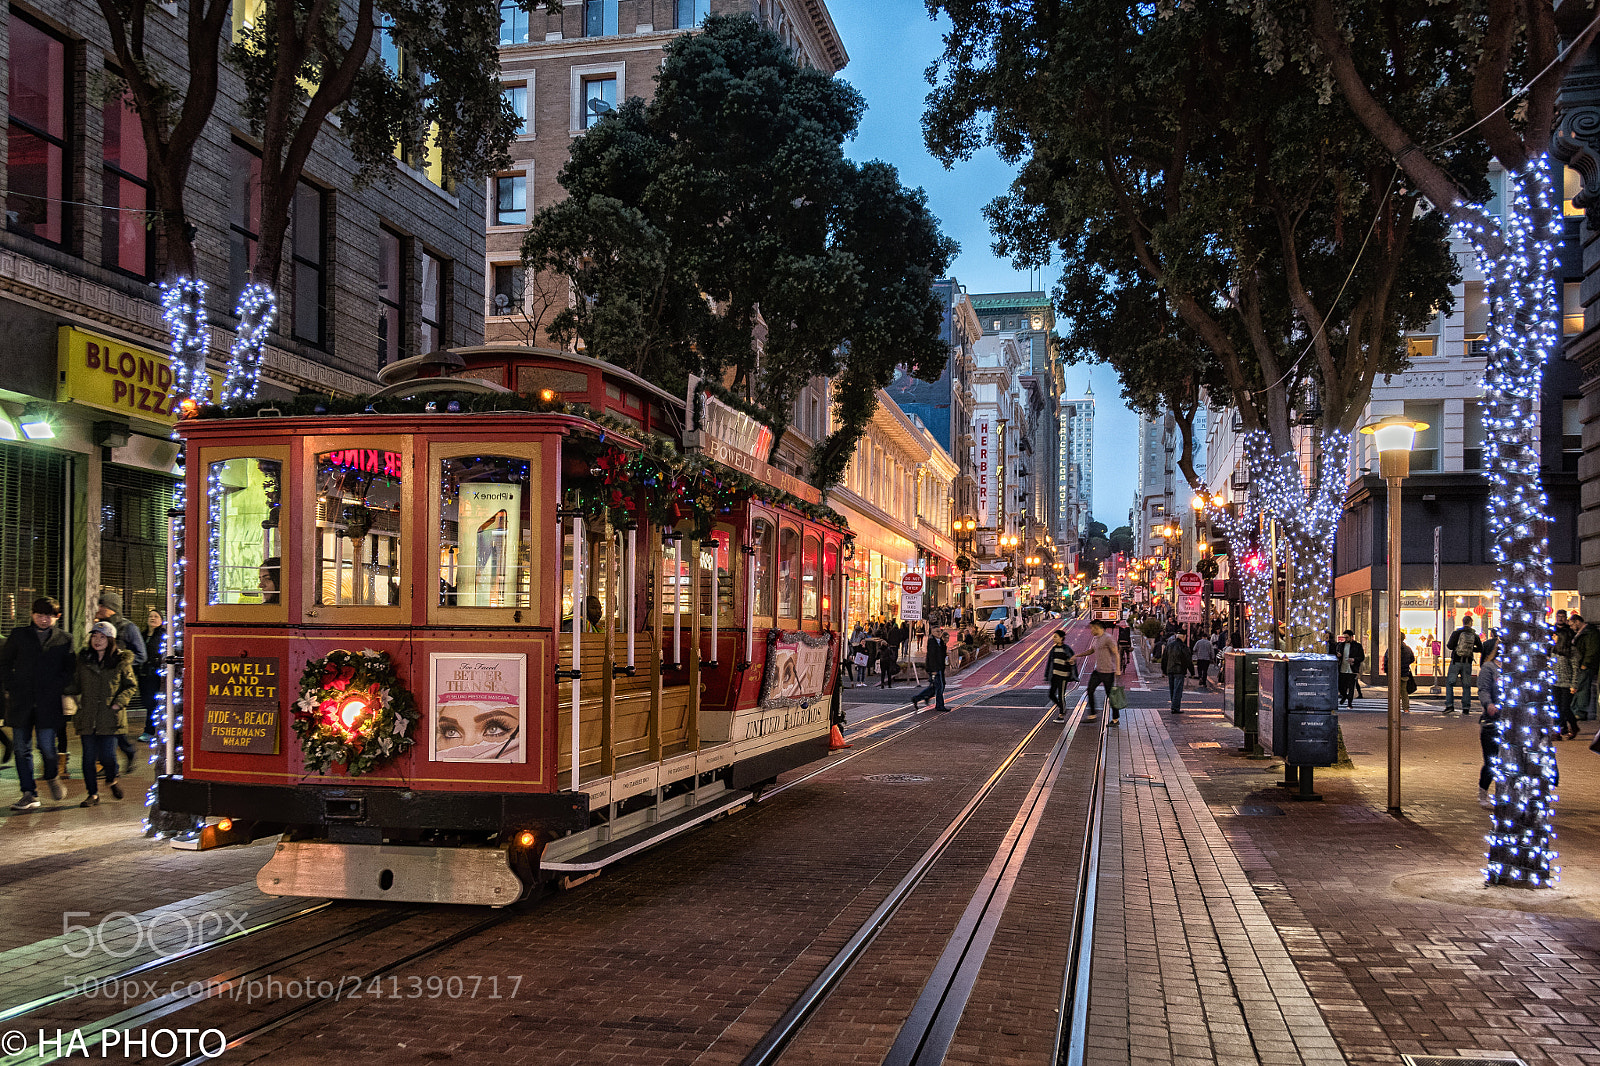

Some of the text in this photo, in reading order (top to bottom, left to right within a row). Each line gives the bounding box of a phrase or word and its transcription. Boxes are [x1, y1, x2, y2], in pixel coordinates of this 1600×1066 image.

[1059, 414, 1067, 481] CHANCELLOR
[710, 441, 755, 474] POWELL
[980, 423, 988, 510] HERBERT
[210, 662, 275, 676] POWELL
[453, 670, 503, 681] BETTER
[227, 675, 259, 685] AND
[446, 681, 510, 692] THAN SEX
[209, 684, 276, 698] MARKET
[207, 710, 231, 724] HYDE
[244, 711, 275, 726] BEACH
[211, 726, 267, 737] FISHERMANS
[745, 715, 781, 738] UNITED
[223, 736, 252, 747] WHARF
